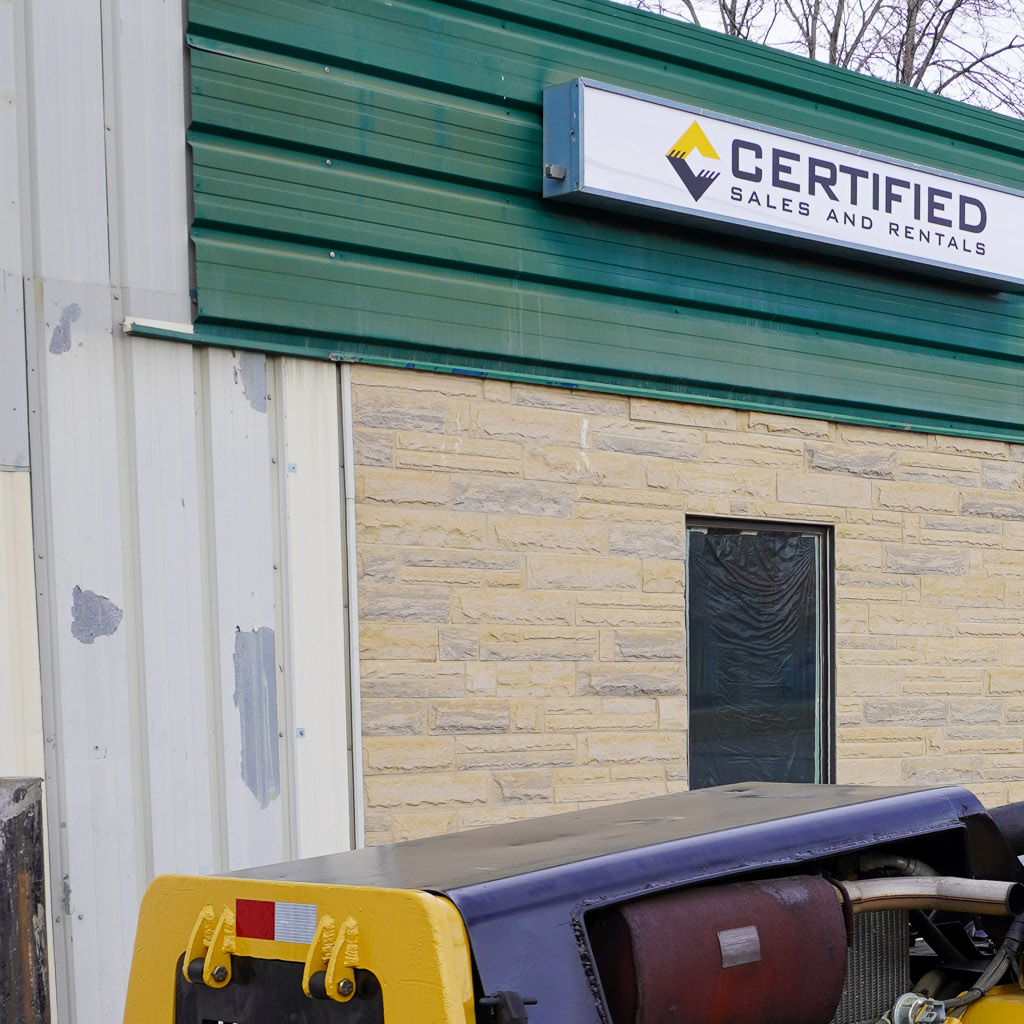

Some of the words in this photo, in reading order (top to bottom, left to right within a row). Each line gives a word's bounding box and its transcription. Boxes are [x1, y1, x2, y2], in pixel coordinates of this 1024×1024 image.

[731, 187, 810, 216] SALES
[826, 208, 873, 230] AND
[889, 222, 986, 256] RENTALS
[732, 139, 987, 233] CERTIFIED
